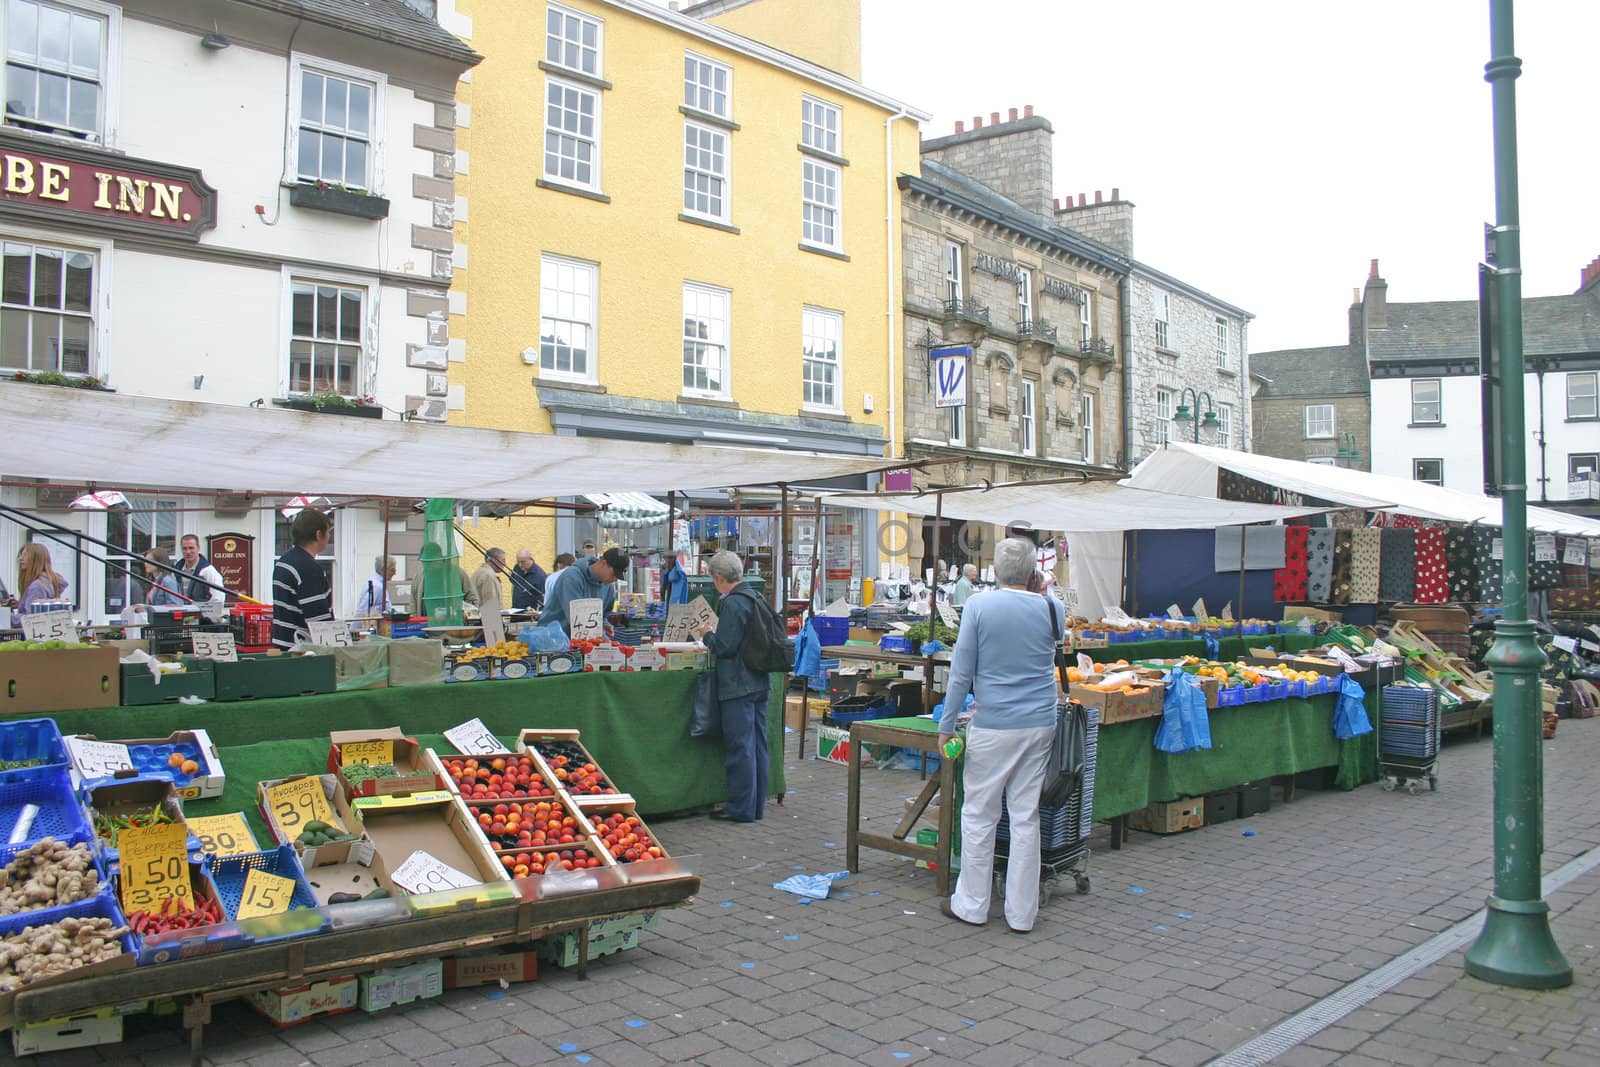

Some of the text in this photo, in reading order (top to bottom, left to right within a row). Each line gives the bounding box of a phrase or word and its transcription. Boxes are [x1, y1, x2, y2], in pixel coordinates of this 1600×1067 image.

[0, 154, 192, 222] BE INN.
[938, 359, 965, 399] W
[573, 613, 598, 630] 45
[195, 640, 231, 657] 35
[345, 742, 385, 755] CRESS
[198, 832, 236, 853] 80
[246, 884, 281, 910] 15
